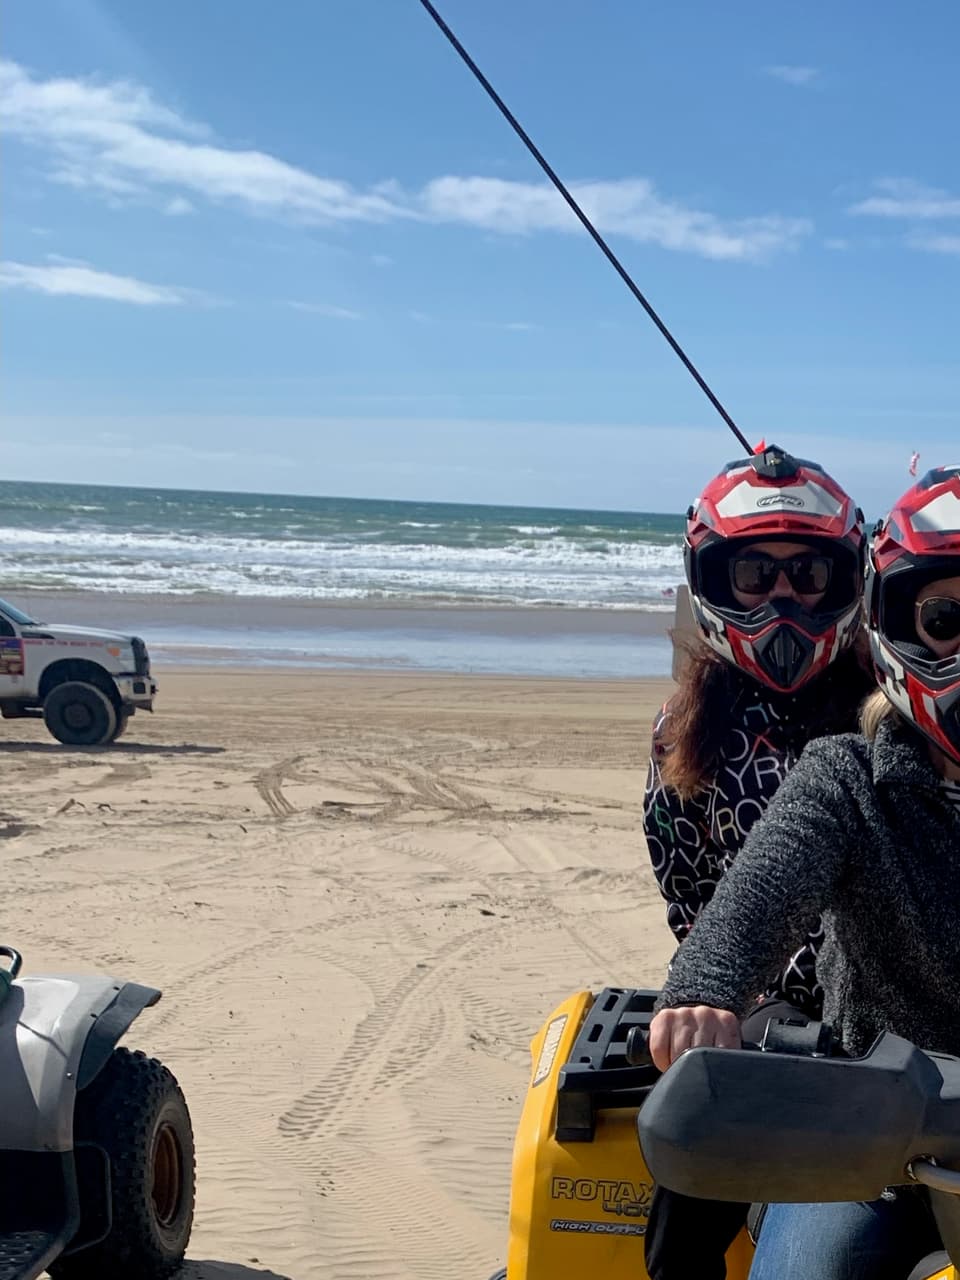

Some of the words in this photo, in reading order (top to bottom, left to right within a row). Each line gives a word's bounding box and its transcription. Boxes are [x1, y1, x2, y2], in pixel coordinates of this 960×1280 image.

[552, 1177, 654, 1205] ROTAX
[553, 1221, 591, 1231] HIGH
[595, 1223, 647, 1234] OUTPU
